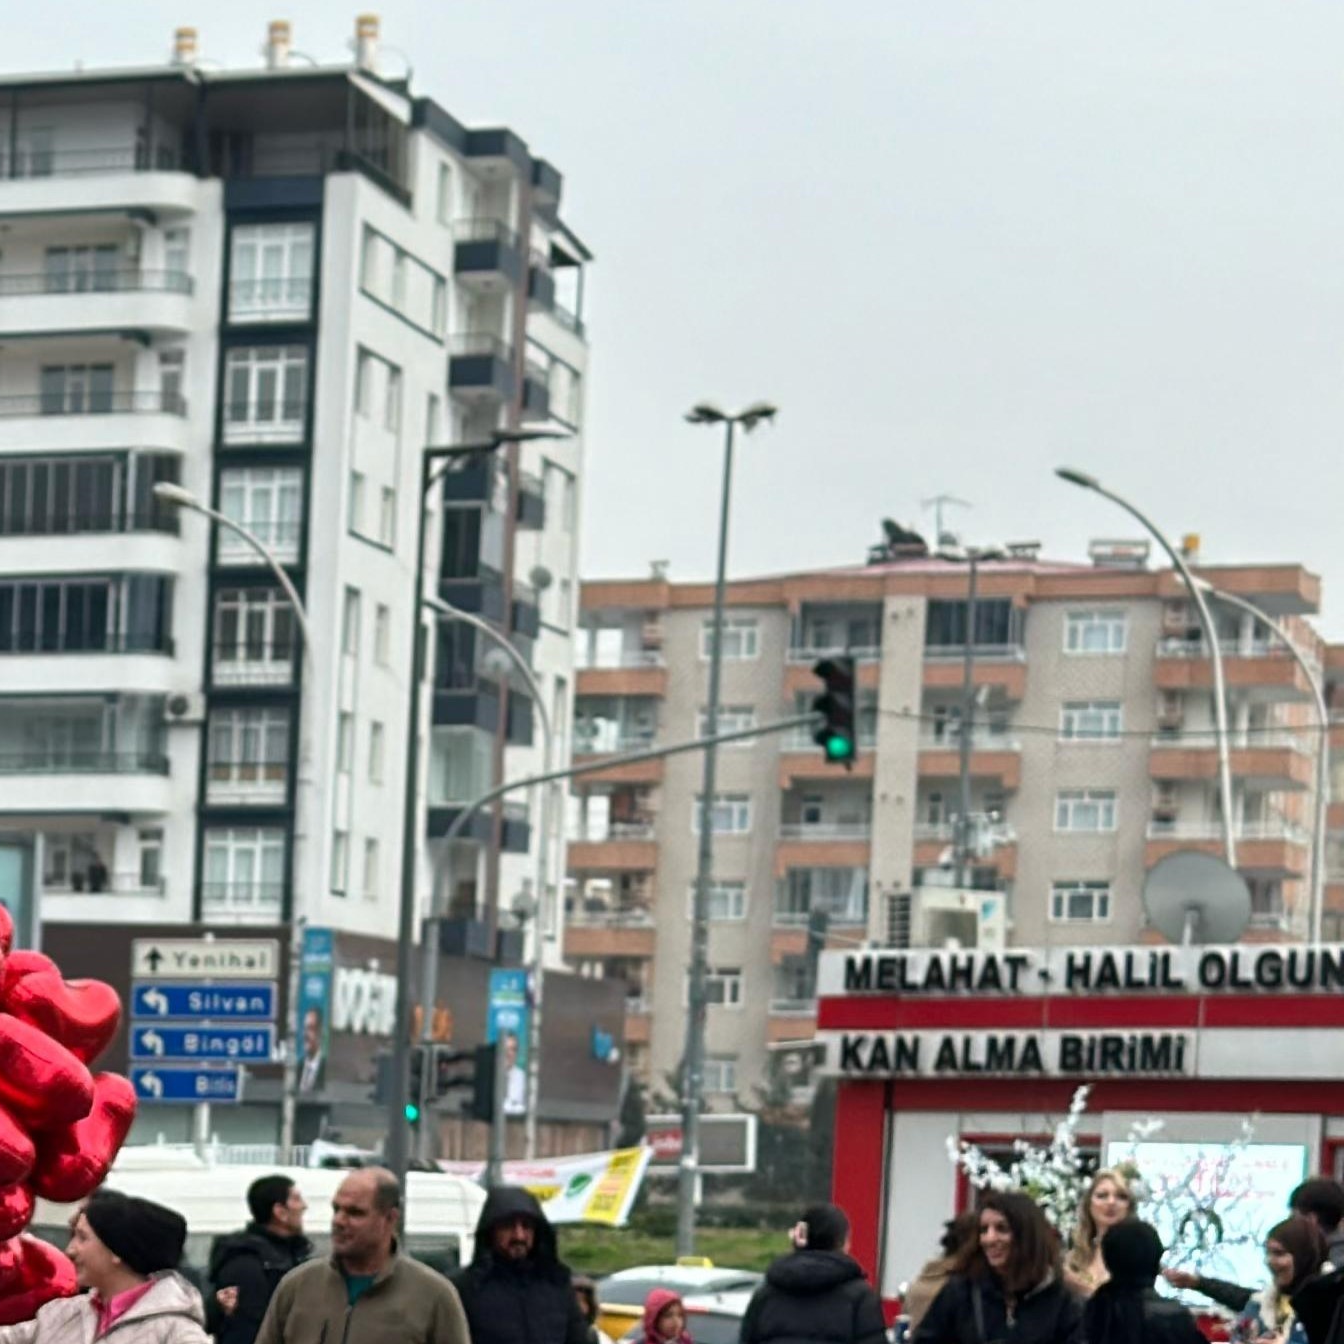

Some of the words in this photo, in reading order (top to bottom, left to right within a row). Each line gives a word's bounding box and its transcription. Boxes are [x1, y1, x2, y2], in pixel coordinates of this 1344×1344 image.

[172, 951, 267, 968] Yenihal
[843, 954, 1030, 992] MELAHAT
[1065, 952, 1183, 989] HALİL
[1197, 950, 1344, 989] OLGUN
[188, 991, 265, 1012] Silvan
[184, 1033, 264, 1055] Bingöl
[840, 1035, 920, 1072] KAN
[933, 1035, 1045, 1072] ALMA
[1058, 1033, 1185, 1073] BİRİMİ
